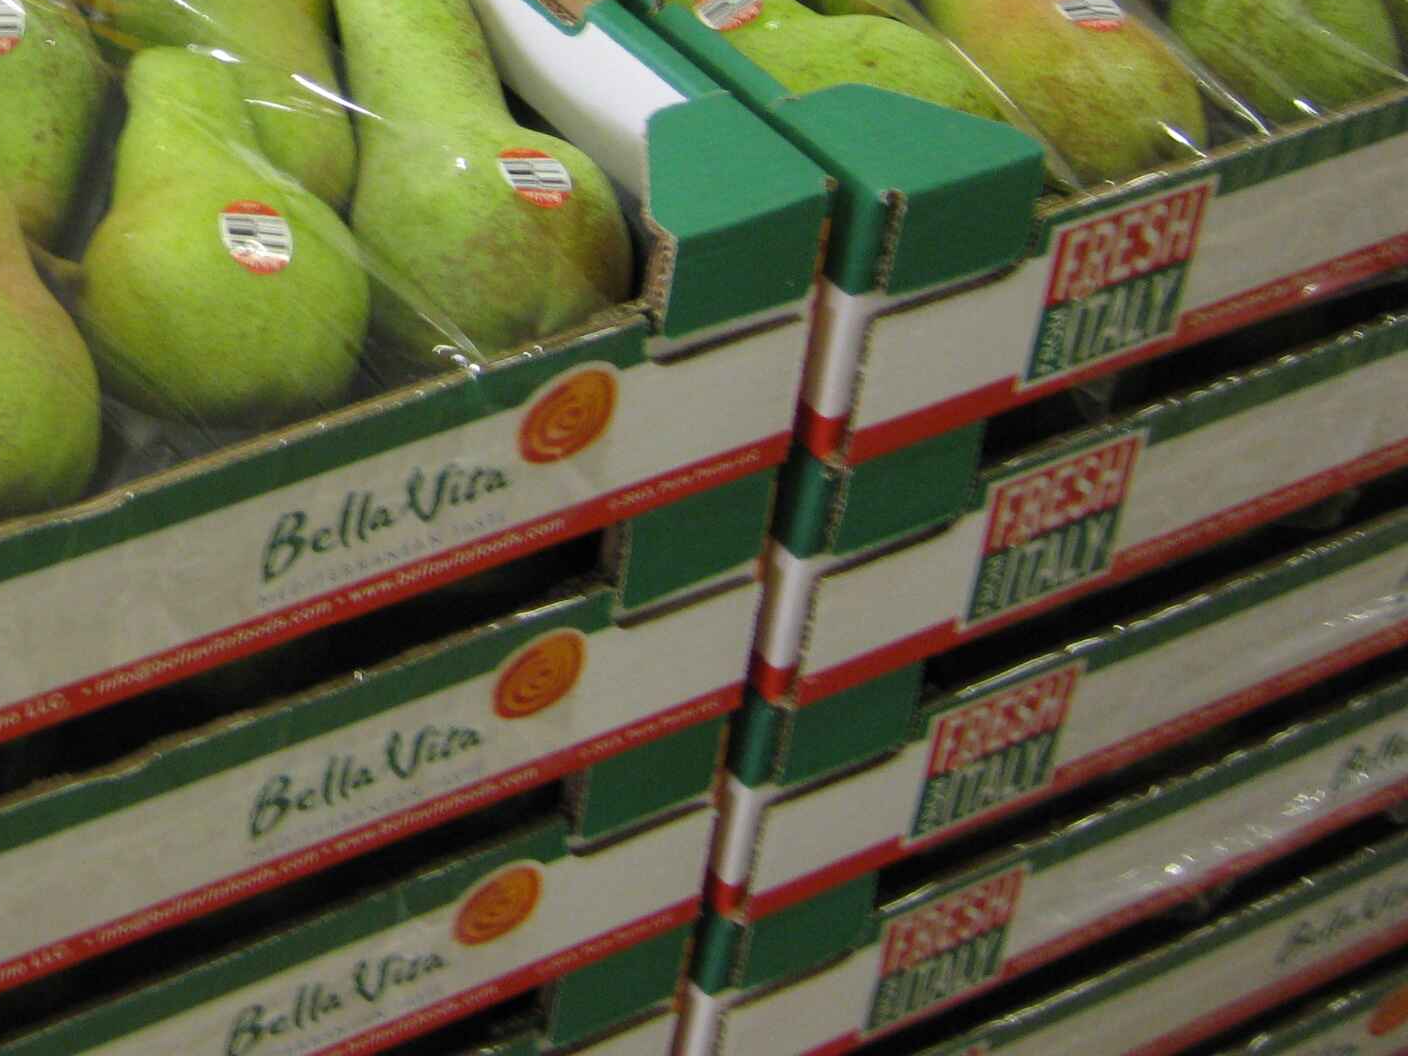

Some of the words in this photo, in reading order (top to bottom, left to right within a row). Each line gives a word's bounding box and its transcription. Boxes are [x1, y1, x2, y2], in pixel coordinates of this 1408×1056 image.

[1054, 192, 1198, 301] FRESH
[1062, 268, 1184, 367] ITALY
[261, 491, 396, 584] Bella
[405, 464, 511, 523] Vita
[989, 445, 1130, 550] FRESH
[1000, 513, 1116, 607] ITALY
[930, 672, 1070, 773] FRESH
[247, 754, 376, 838] Bella
[385, 724, 483, 779] Vita
[944, 732, 1052, 823] ITALY
[882, 874, 1018, 977] FRESH
[894, 928, 1002, 1014] ITALY
[225, 981, 342, 1056] Bella
[353, 953, 448, 1003] Vita
